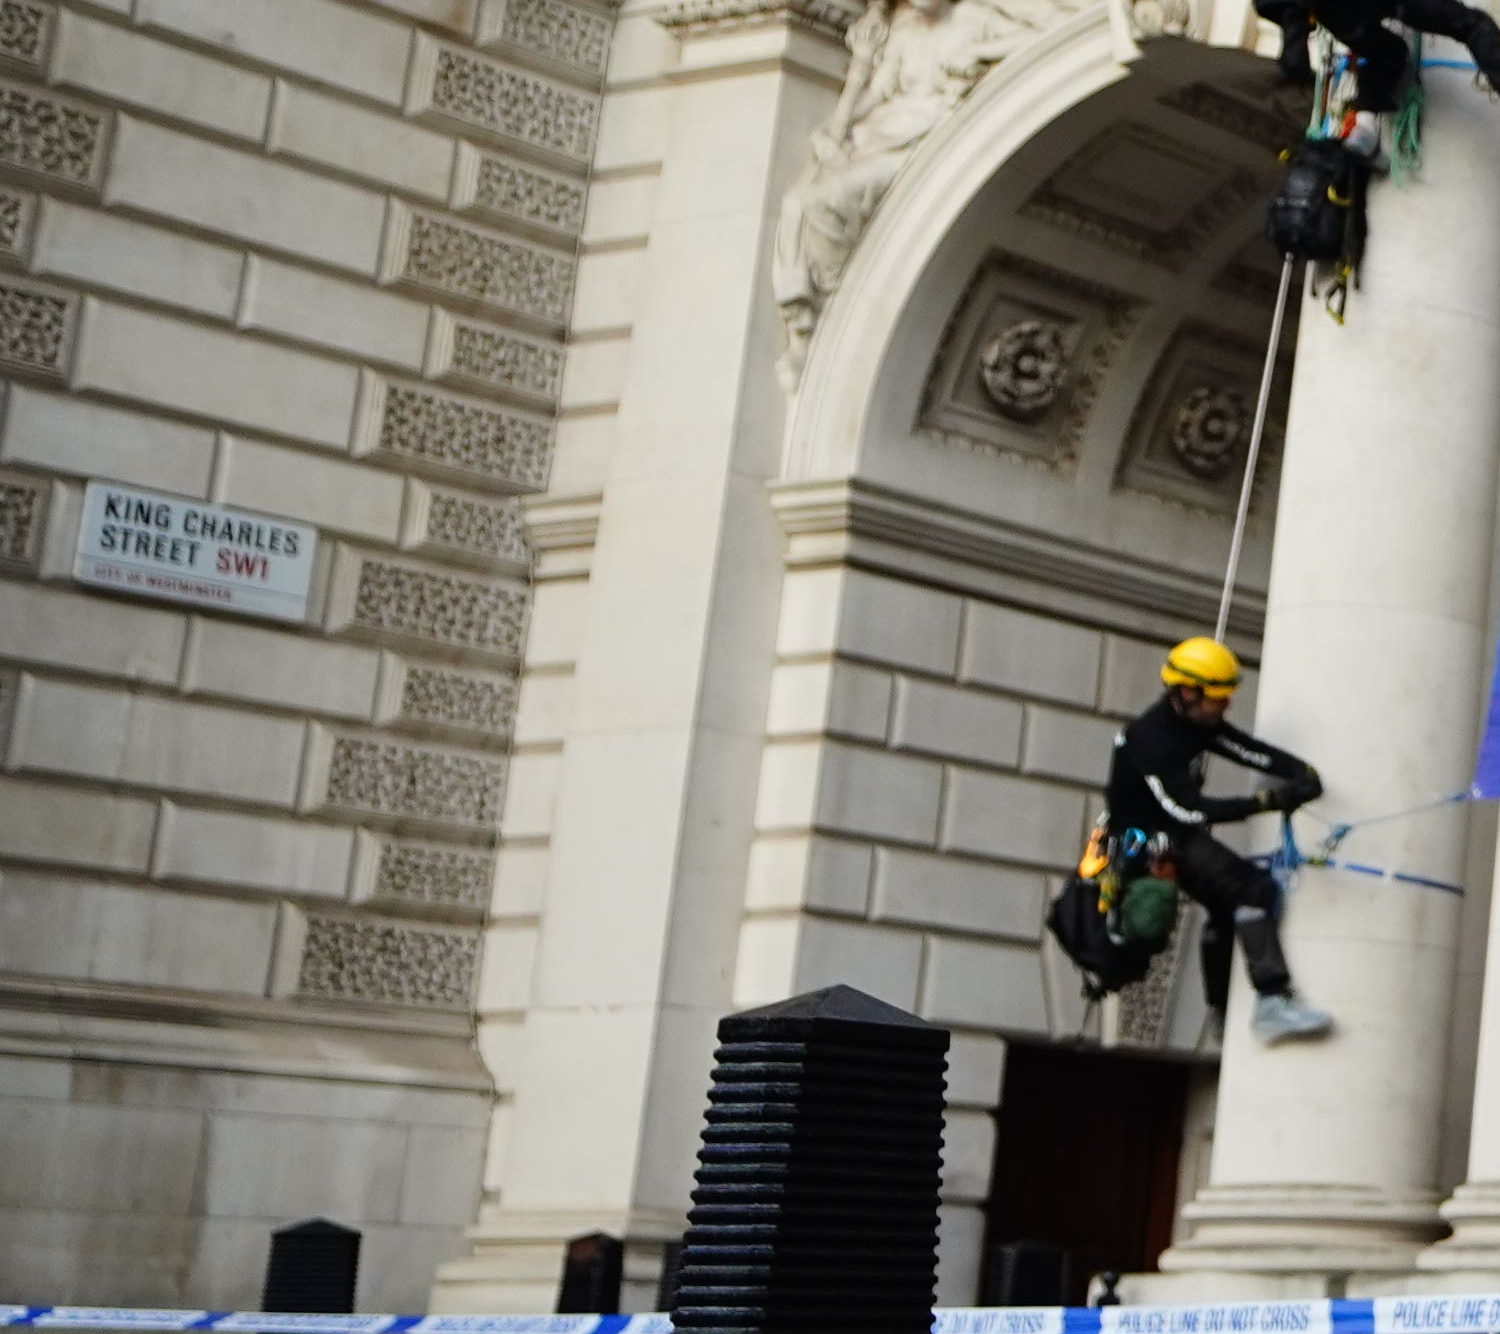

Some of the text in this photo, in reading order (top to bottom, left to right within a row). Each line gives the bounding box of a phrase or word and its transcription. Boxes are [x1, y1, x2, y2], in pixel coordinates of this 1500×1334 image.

[105, 493, 299, 555] KING CHARLES
[100, 523, 268, 582] STREET SW1
[1261, 1304, 1310, 1331] CROSS
[1393, 1299, 1445, 1328] POLICE
[1451, 1299, 1484, 1327] LINE
